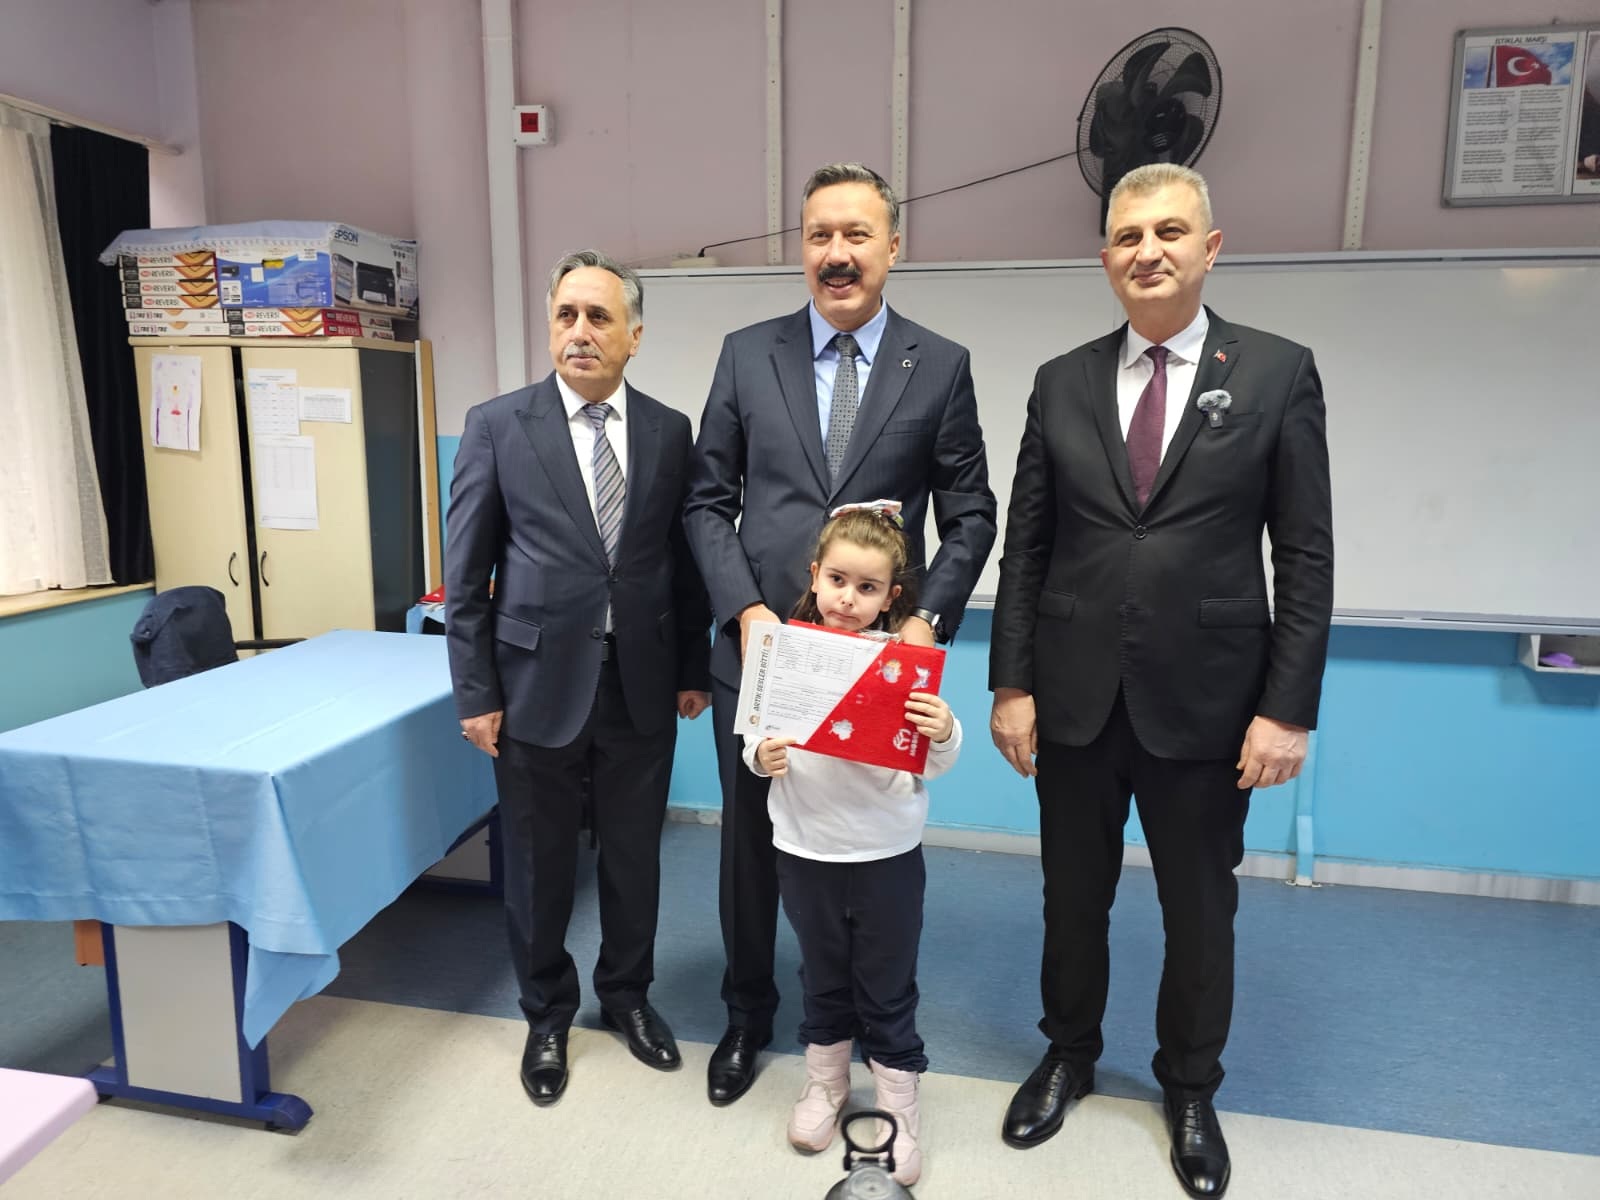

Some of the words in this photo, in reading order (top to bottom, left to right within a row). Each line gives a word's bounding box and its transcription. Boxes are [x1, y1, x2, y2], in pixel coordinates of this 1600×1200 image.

[334, 229, 359, 243] EPSON
[756, 669, 766, 693] SESLER
[753, 693, 762, 712] ARTIK
